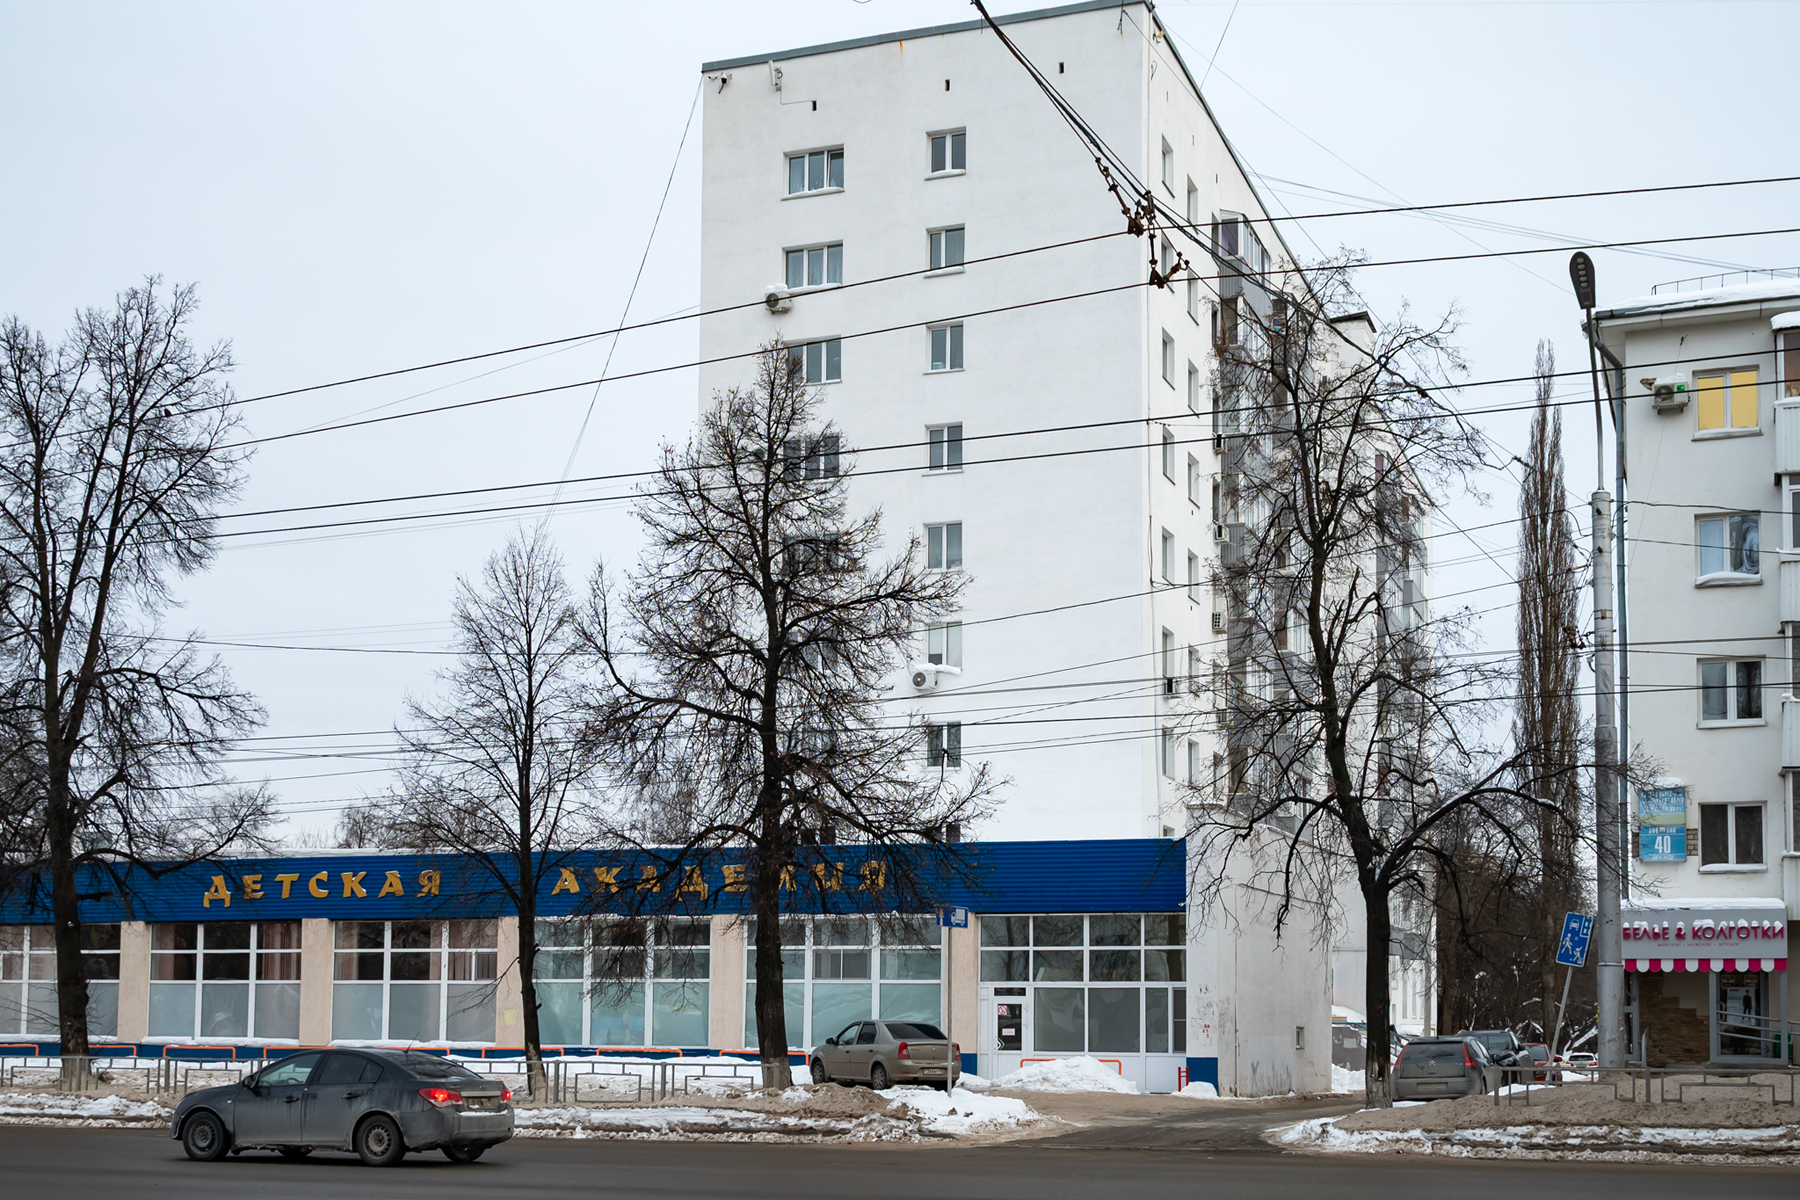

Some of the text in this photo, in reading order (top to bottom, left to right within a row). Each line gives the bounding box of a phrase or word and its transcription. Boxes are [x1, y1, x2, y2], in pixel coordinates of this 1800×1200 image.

[1654, 835, 1671, 854] 40
[203, 870, 442, 908] ДЕТСКАЯ
[1622, 926, 1785, 940] БЕЛЬЕ & КОЛГОТКИ
